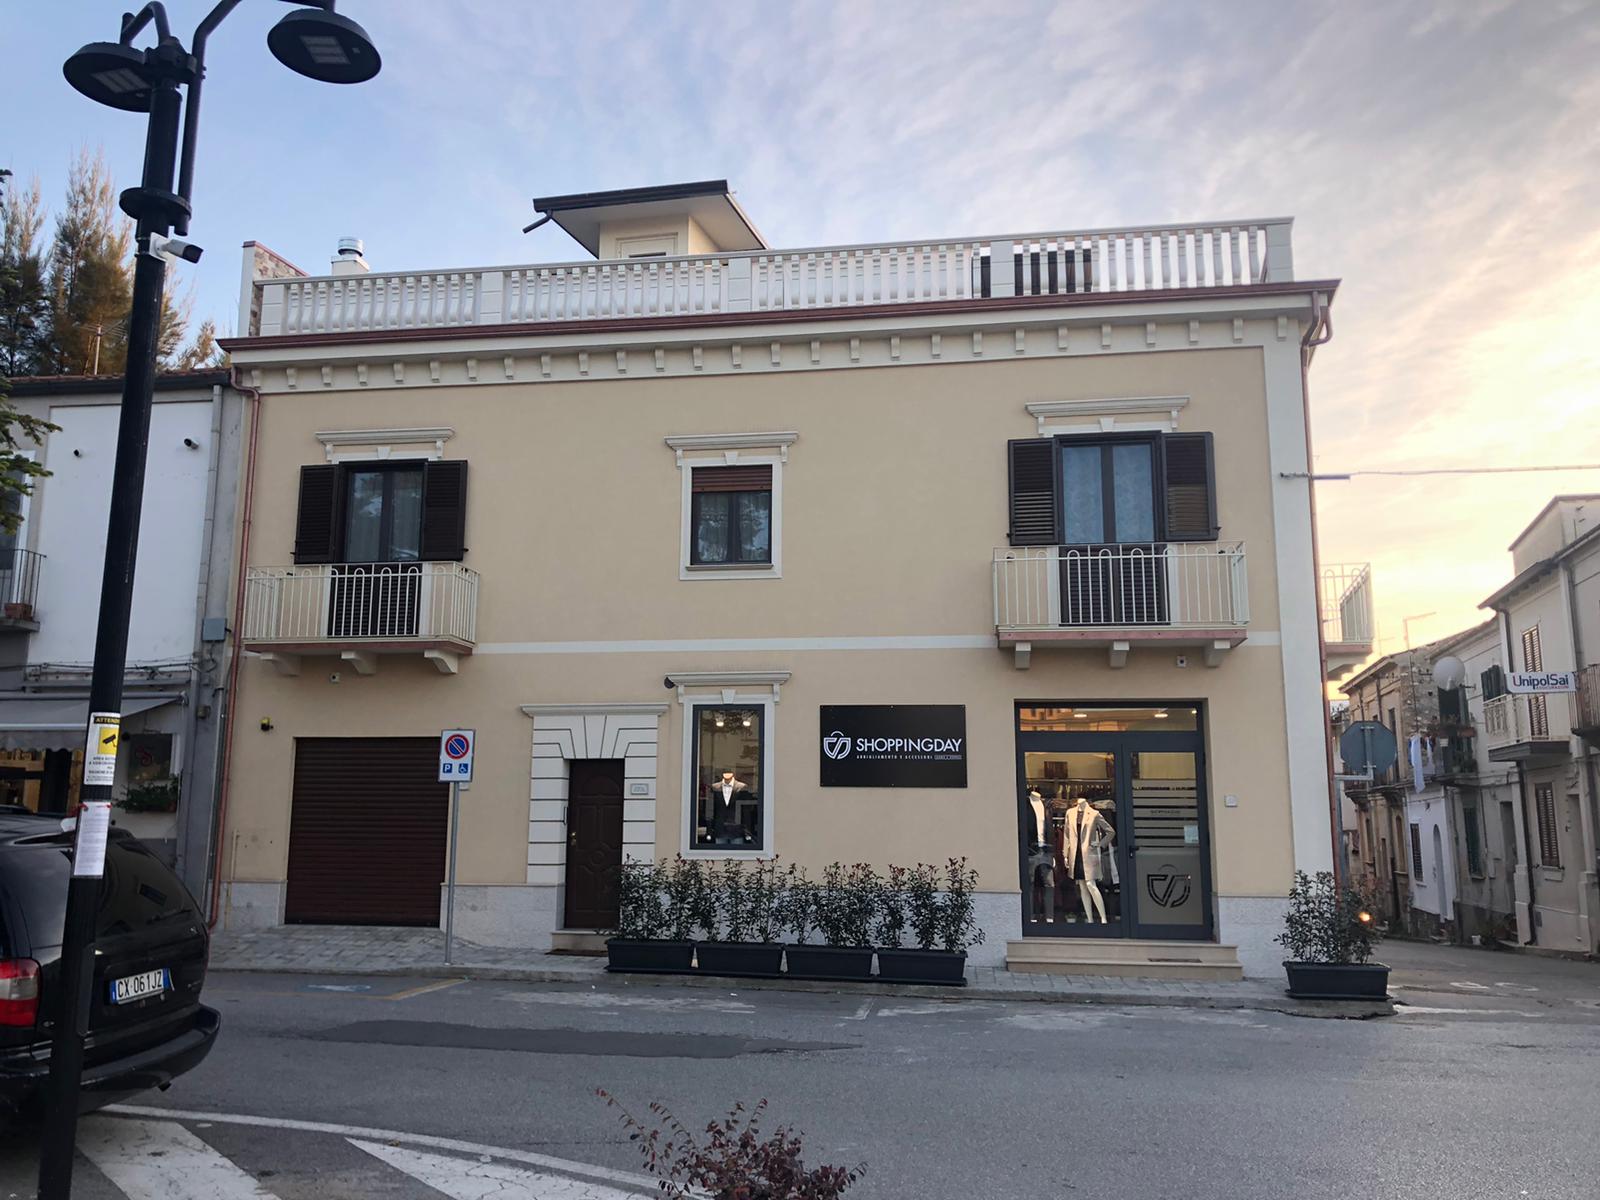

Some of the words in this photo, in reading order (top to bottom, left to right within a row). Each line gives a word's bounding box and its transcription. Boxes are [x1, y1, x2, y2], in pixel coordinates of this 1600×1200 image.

[1513, 673, 1569, 690] UnipolSai
[856, 738, 962, 752] SHOPPINGDAY
[444, 764, 451, 772] P
[118, 979, 130, 998] CX
